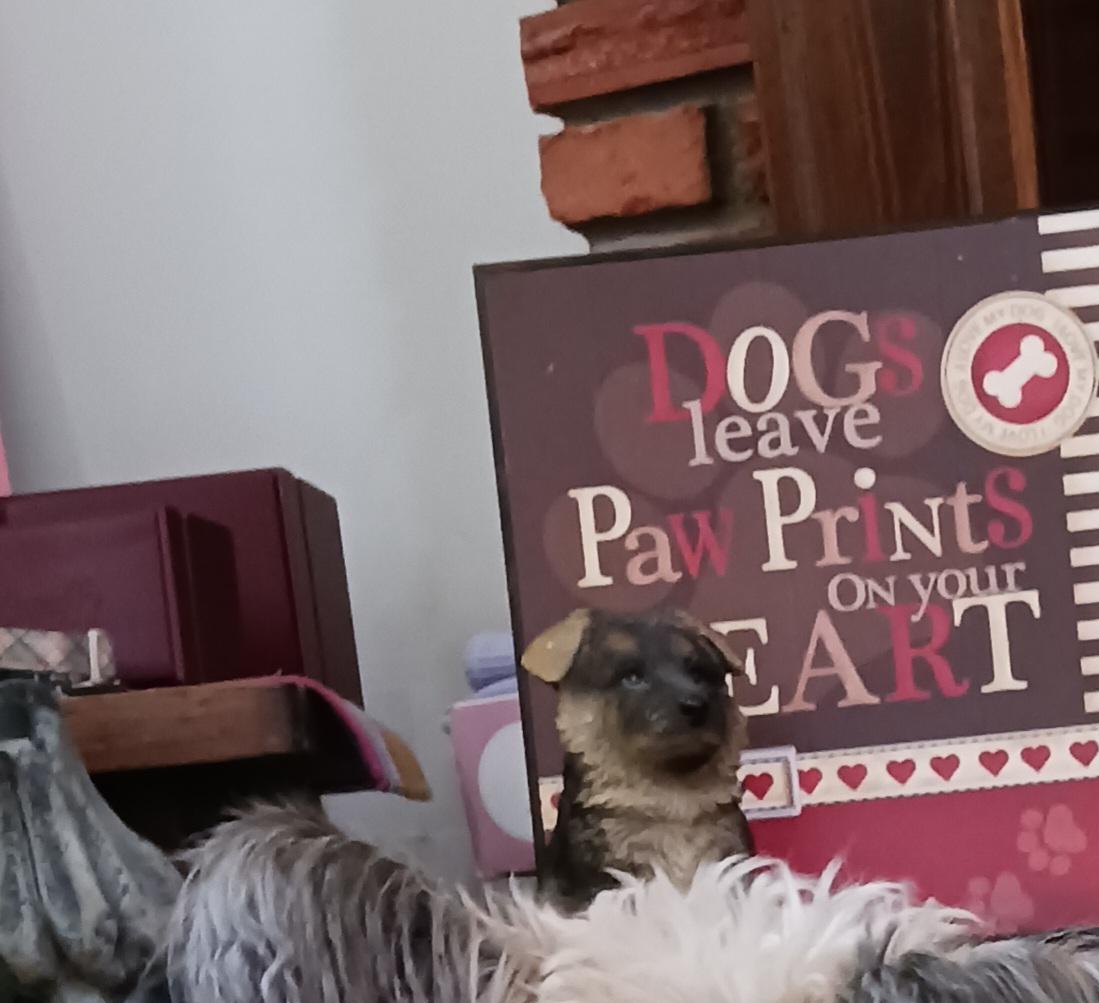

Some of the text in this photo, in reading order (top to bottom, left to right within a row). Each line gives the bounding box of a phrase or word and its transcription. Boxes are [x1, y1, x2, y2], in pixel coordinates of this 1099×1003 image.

[633, 311, 924, 424] DOGS
[685, 400, 883, 468] leave
[567, 484, 733, 588] Paw
[827, 562, 1027, 621] ON your
[709, 590, 1041, 717] EART
